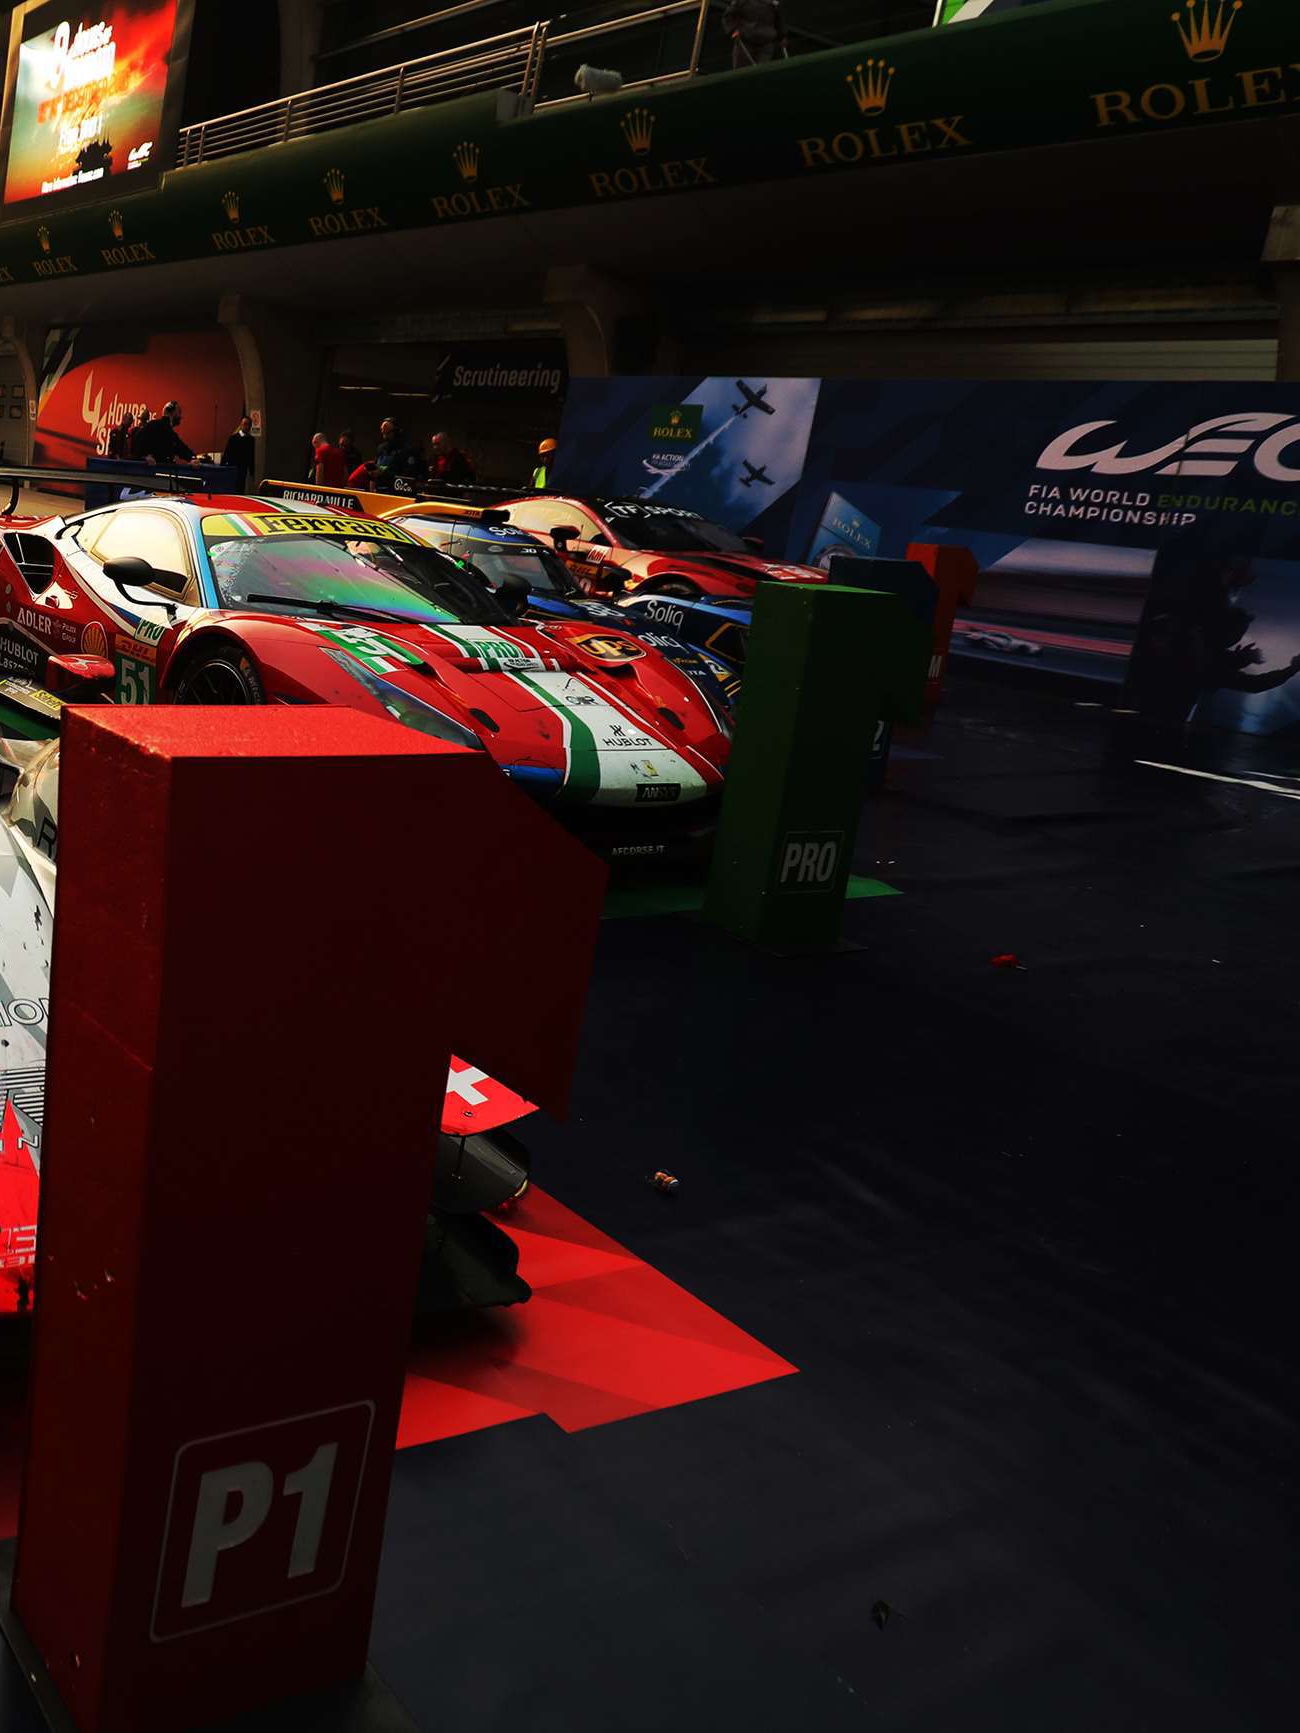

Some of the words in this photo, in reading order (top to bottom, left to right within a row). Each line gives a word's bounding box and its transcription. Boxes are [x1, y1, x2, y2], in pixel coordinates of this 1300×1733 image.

[1089, 63, 1300, 127] ROLE
[796, 115, 973, 168] ROLEX
[588, 157, 717, 198] ROLEX
[429, 183, 532, 219] ROLEX
[308, 207, 388, 237] ROLEX
[212, 225, 276, 251] ROLEX
[33, 256, 79, 277] ROLEX
[101, 242, 156, 266] ROLEX
[452, 360, 562, 394] Scrutineering
[653, 427, 693, 438] ROLEX
[1024, 500, 1197, 526] CHAMPIONSHIP
[1028, 484, 1061, 499] FIA
[1069, 487, 1151, 507] WORLD
[1157, 494, 1300, 517] ENDURANC
[253, 515, 406, 541] Ferrari
[832, 517, 872, 549] ROLEX
[17, 607, 52, 635] ADLER
[136, 618, 165, 641] PRO
[0, 637, 39, 666] HUBLOT
[480, 640, 519, 658] PRO
[580, 637, 639, 657] ups
[637, 631, 690, 654] oliq
[120, 658, 152, 704] 51
[602, 738, 653, 748] HUBLOT
[780, 841, 837, 884] PRO
[181, 1441, 339, 1609] P1
